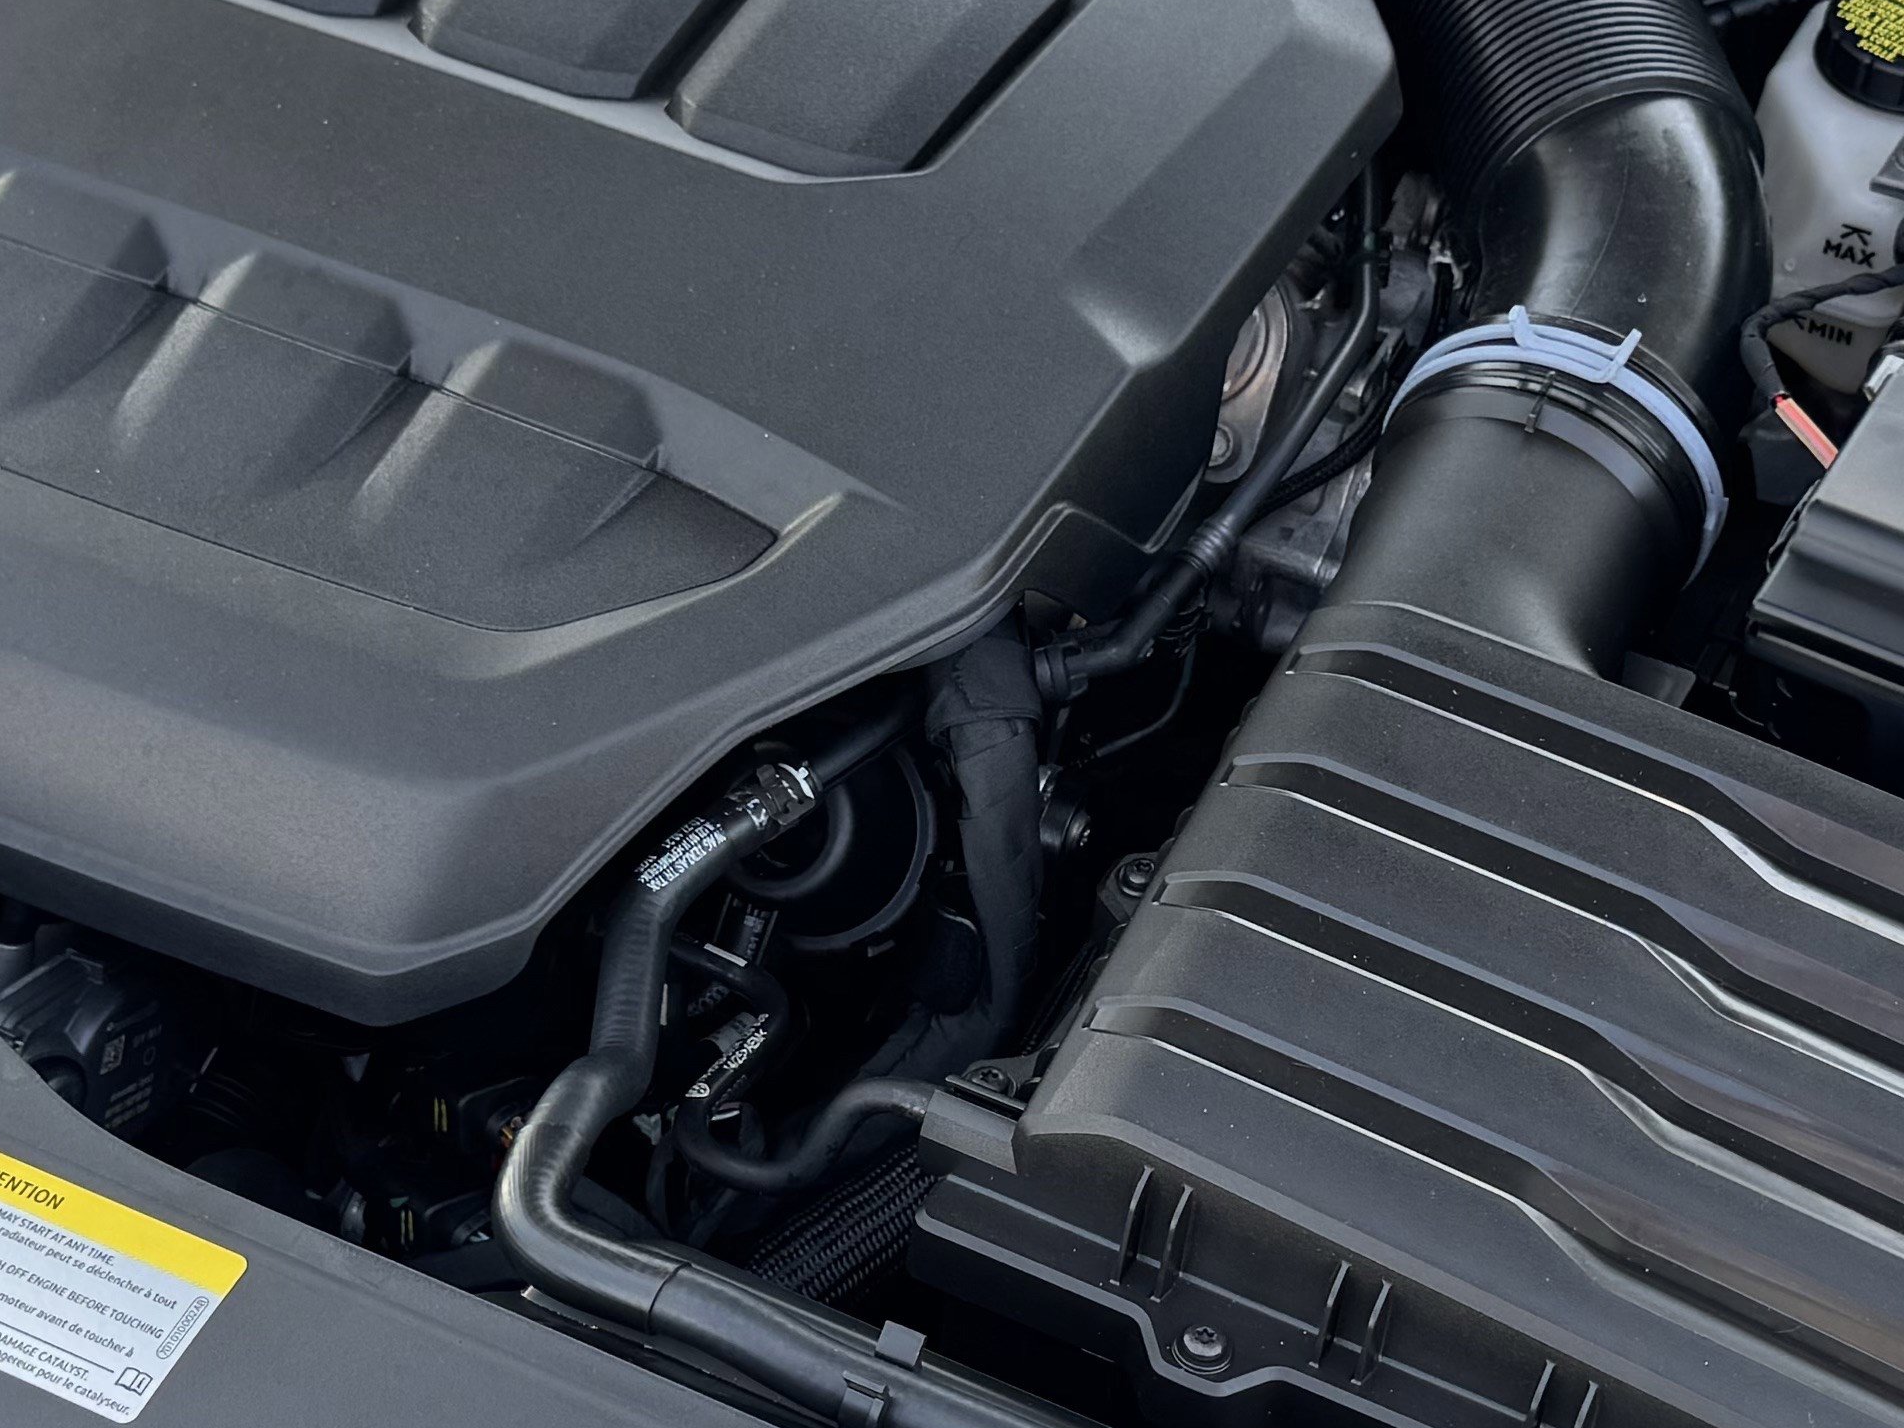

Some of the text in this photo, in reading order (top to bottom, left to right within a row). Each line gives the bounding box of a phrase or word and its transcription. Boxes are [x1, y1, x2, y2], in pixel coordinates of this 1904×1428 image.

[1808, 319, 1853, 346] MIN
[18, 1218, 53, 1237] START
[49, 1232, 67, 1243] AT
[63, 1238, 89, 1253] ANY
[44, 1248, 73, 1264] peut
[71, 1259, 85, 1270] se
[85, 1264, 144, 1294] déclencher
[143, 1288, 152, 1298] à
[152, 1293, 177, 1310] tout
[5, 1264, 29, 1278] OFF
[26, 1273, 68, 1296] ENGINE
[66, 1290, 110, 1315] BEFORE
[109, 1308, 164, 1339] TOUCHING
[35, 1309, 68, 1328] avant
[68, 1323, 83, 1335] de
[83, 1329, 126, 1353] toucher
[124, 1346, 134, 1358] à
[34, 1368, 63, 1384] pour
[62, 1377, 74, 1390] le
[37, 1351, 89, 1381] CATALYST.
